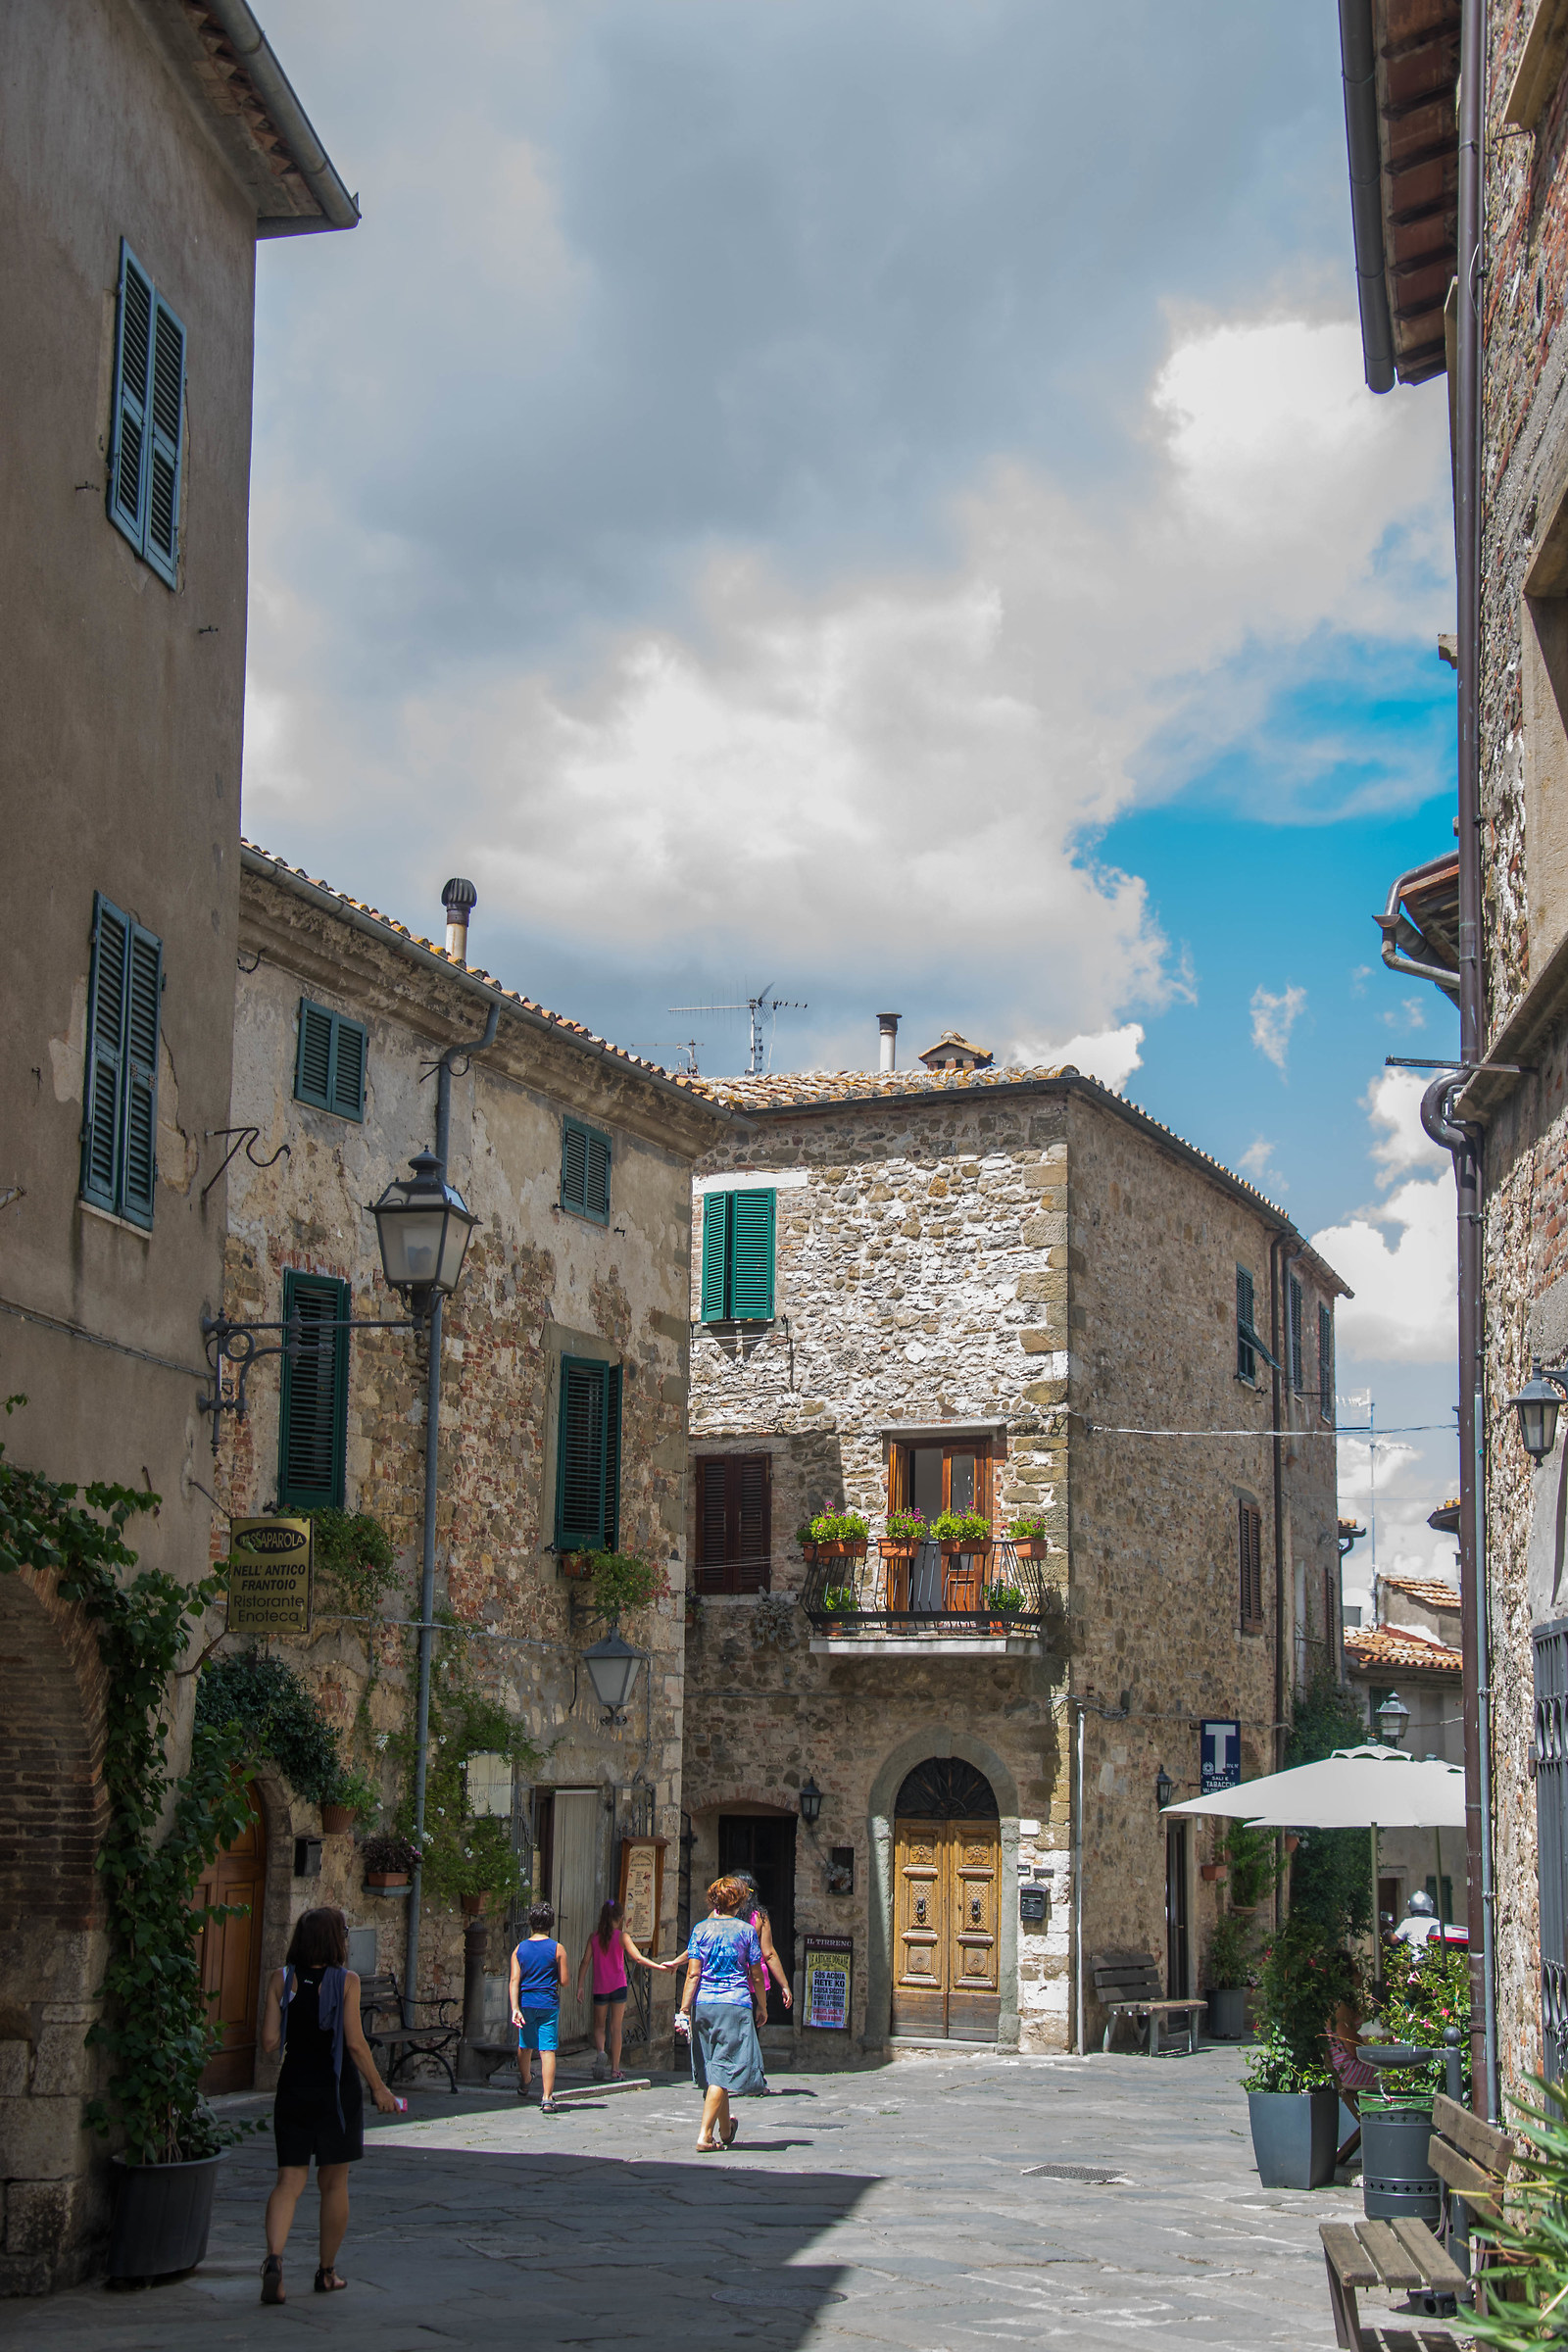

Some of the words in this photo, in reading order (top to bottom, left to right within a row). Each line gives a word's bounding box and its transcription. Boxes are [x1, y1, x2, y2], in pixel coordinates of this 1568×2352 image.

[233, 1565, 262, 1577] NELL'
[265, 1564, 306, 1576] ANTICO
[241, 1579, 296, 1591] FRANTOIO
[234, 1595, 305, 1607] Ristorante
[238, 1610, 299, 1623] Enoteca
[1205, 1724, 1237, 1775] T
[815, 1938, 852, 1947] TIRRENO
